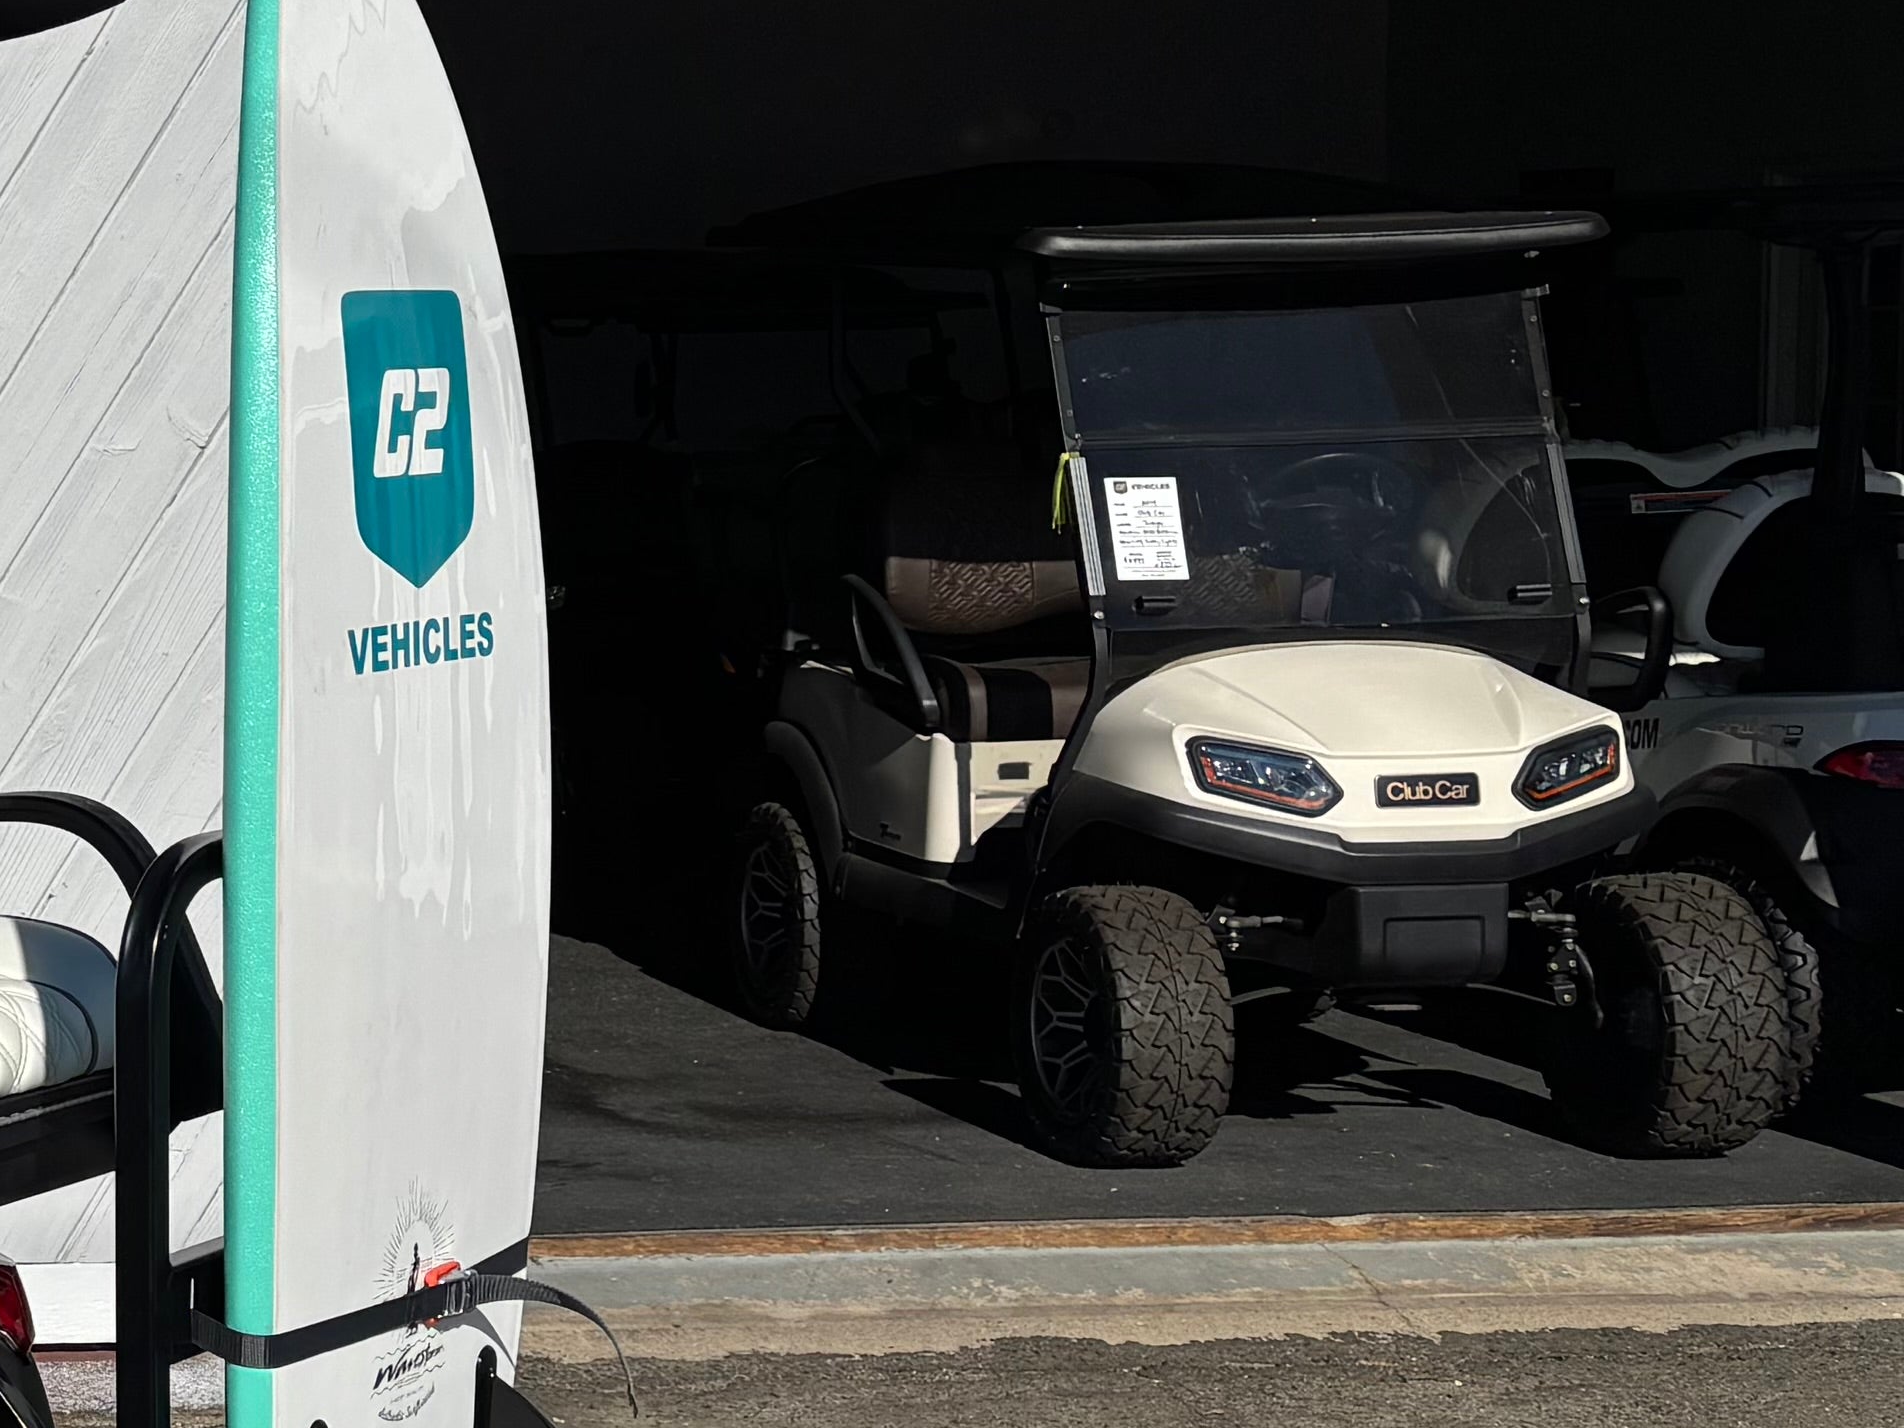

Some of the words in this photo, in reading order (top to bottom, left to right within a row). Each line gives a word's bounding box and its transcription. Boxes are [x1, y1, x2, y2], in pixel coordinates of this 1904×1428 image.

[373, 368, 450, 478] C2
[347, 612, 494, 676] VEHICLES
[1386, 780, 1433, 801] Club
[1435, 779, 1470, 800] Car
